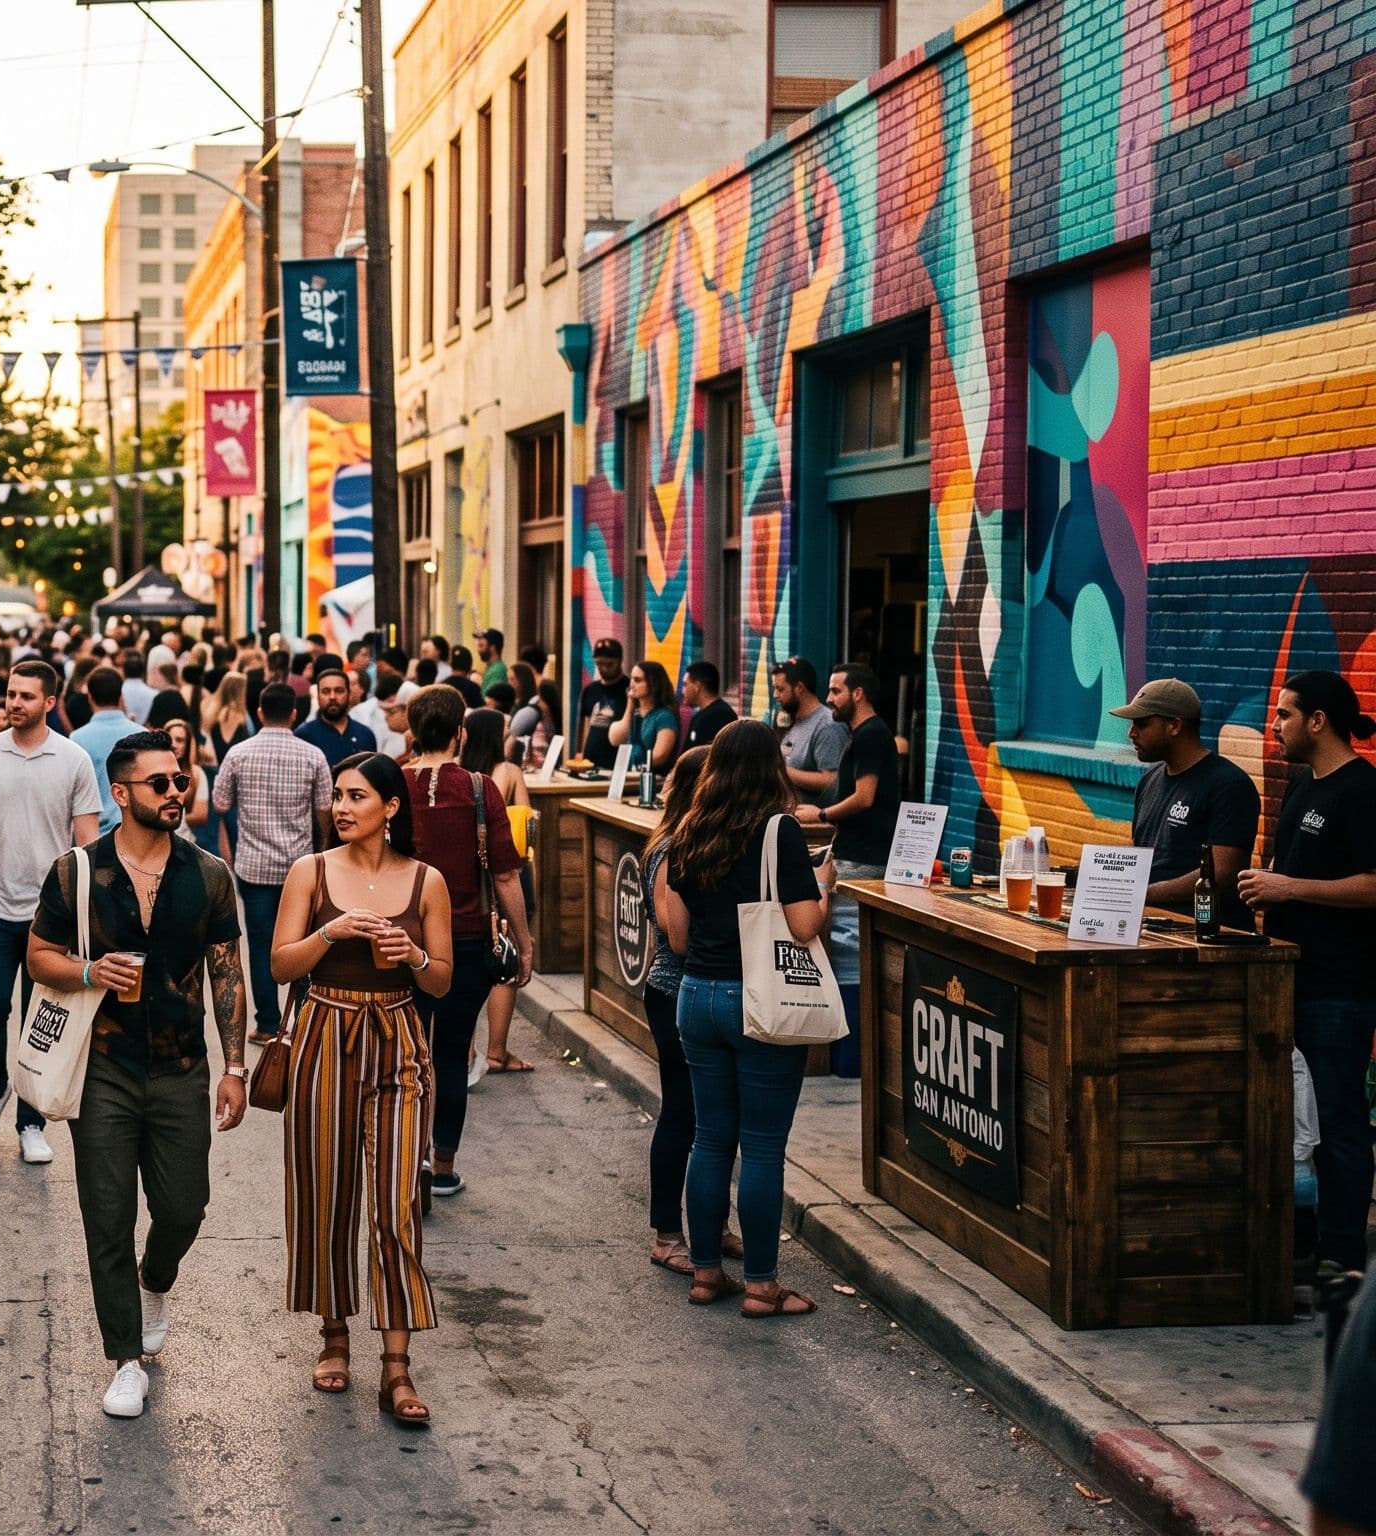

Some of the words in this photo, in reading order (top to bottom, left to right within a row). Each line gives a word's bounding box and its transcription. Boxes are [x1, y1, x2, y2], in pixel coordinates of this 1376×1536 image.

[912, 998, 1004, 1111] CRAFT
[914, 1081, 939, 1118] SAN
[942, 1096, 1003, 1151] ANTONIO
